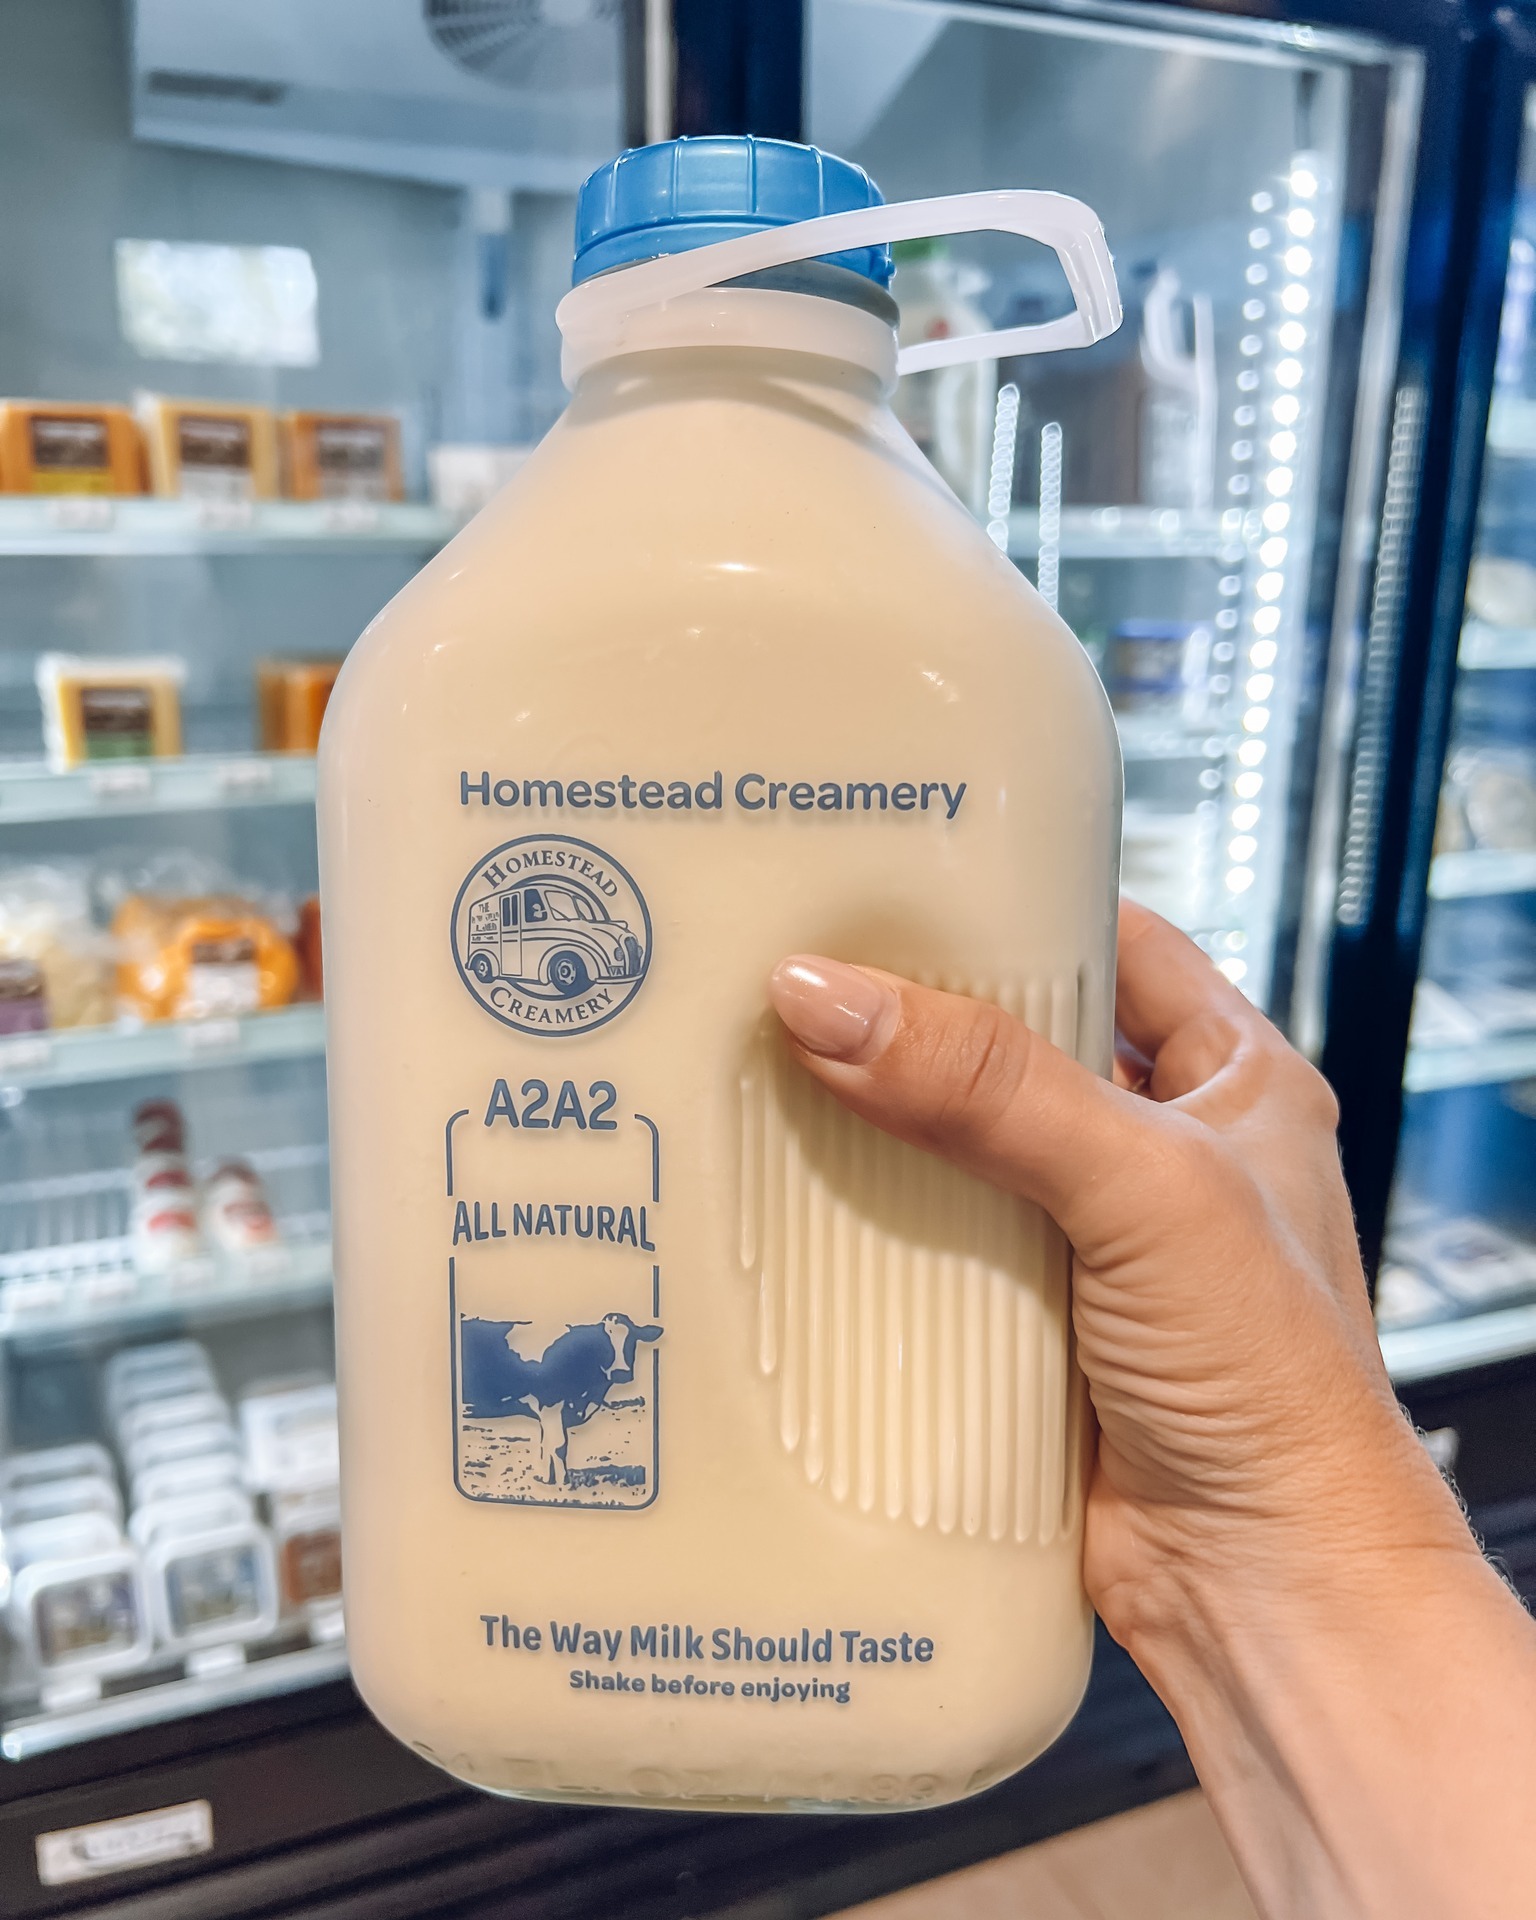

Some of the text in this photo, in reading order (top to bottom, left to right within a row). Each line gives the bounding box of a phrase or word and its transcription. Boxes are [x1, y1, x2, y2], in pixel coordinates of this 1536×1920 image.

[460, 771, 968, 820] Homestead Creamery
[482, 850, 618, 898] HOMESTEAD
[490, 987, 613, 1024] CREAMERY
[484, 1078, 618, 1130] A2A2
[452, 1200, 656, 1252] ALL NATURAL
[480, 1614, 935, 1664] The Way Milk Should Taste
[569, 1669, 851, 1703] Shake before enjoying
